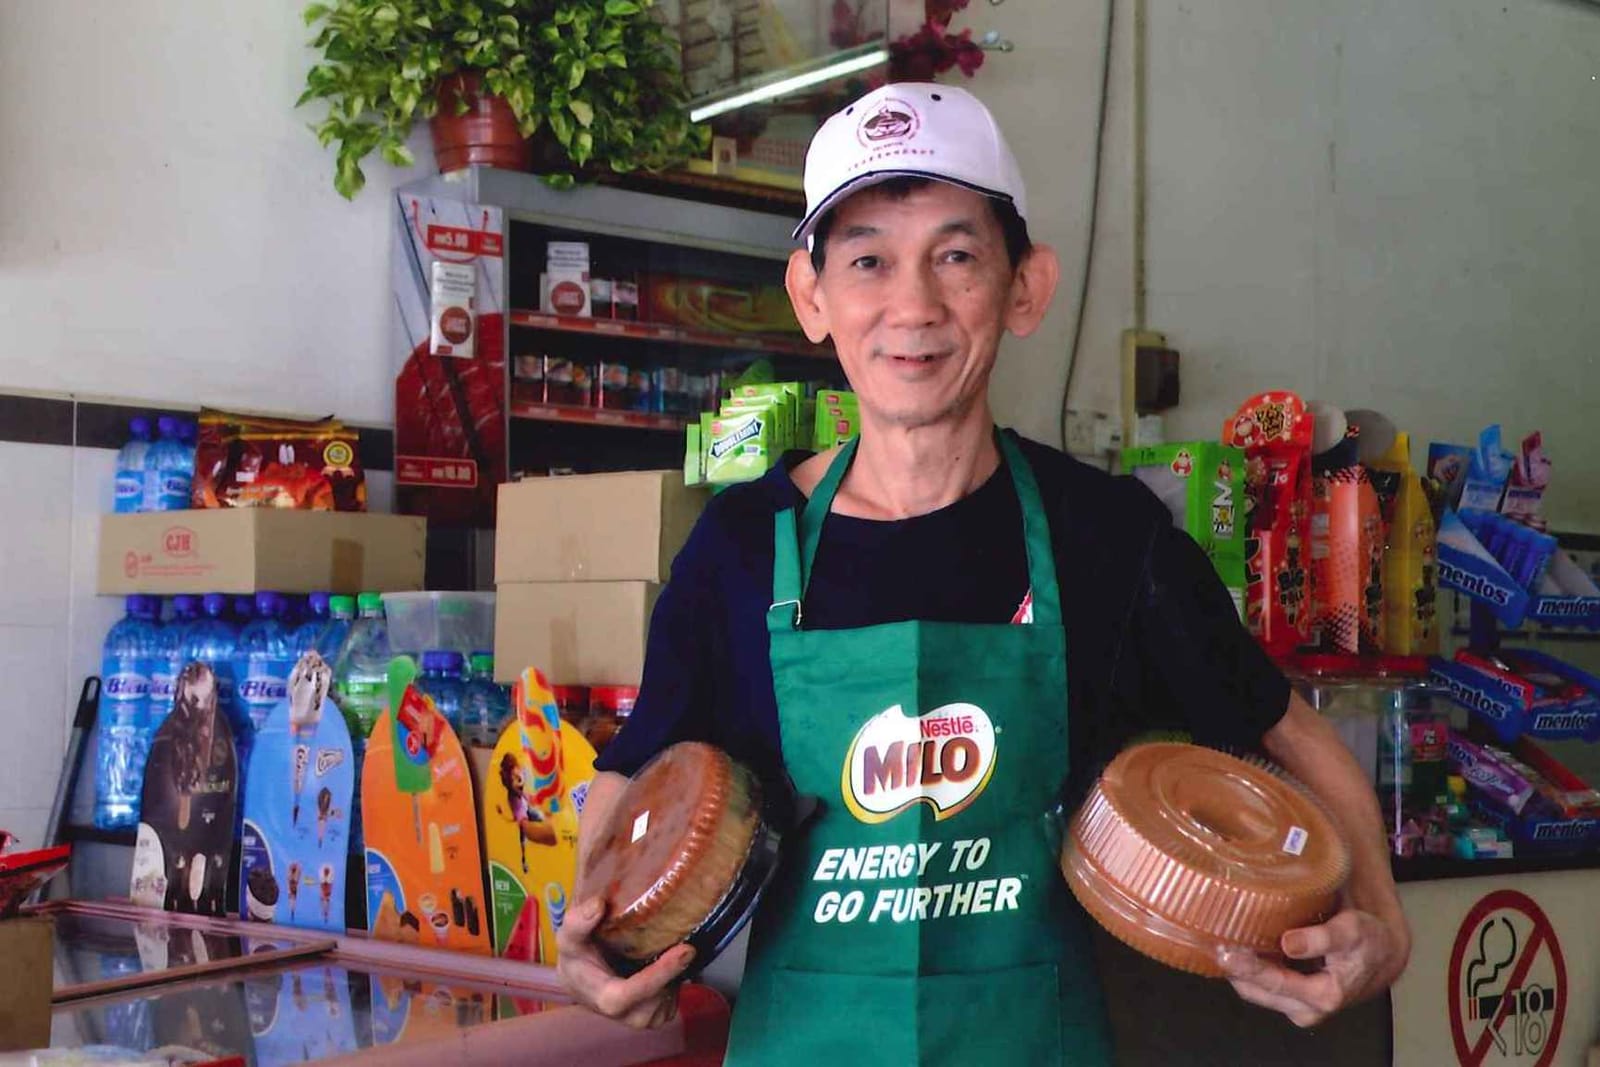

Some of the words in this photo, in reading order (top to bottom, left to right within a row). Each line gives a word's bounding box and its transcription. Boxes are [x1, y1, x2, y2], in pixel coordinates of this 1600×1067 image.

[920, 716, 973, 738] Nestlé
[863, 737, 981, 795] MILO
[813, 842, 942, 881] ENERGY
[949, 837, 991, 873] TO
[813, 890, 865, 924] GO
[868, 876, 1022, 923] FURTHER
